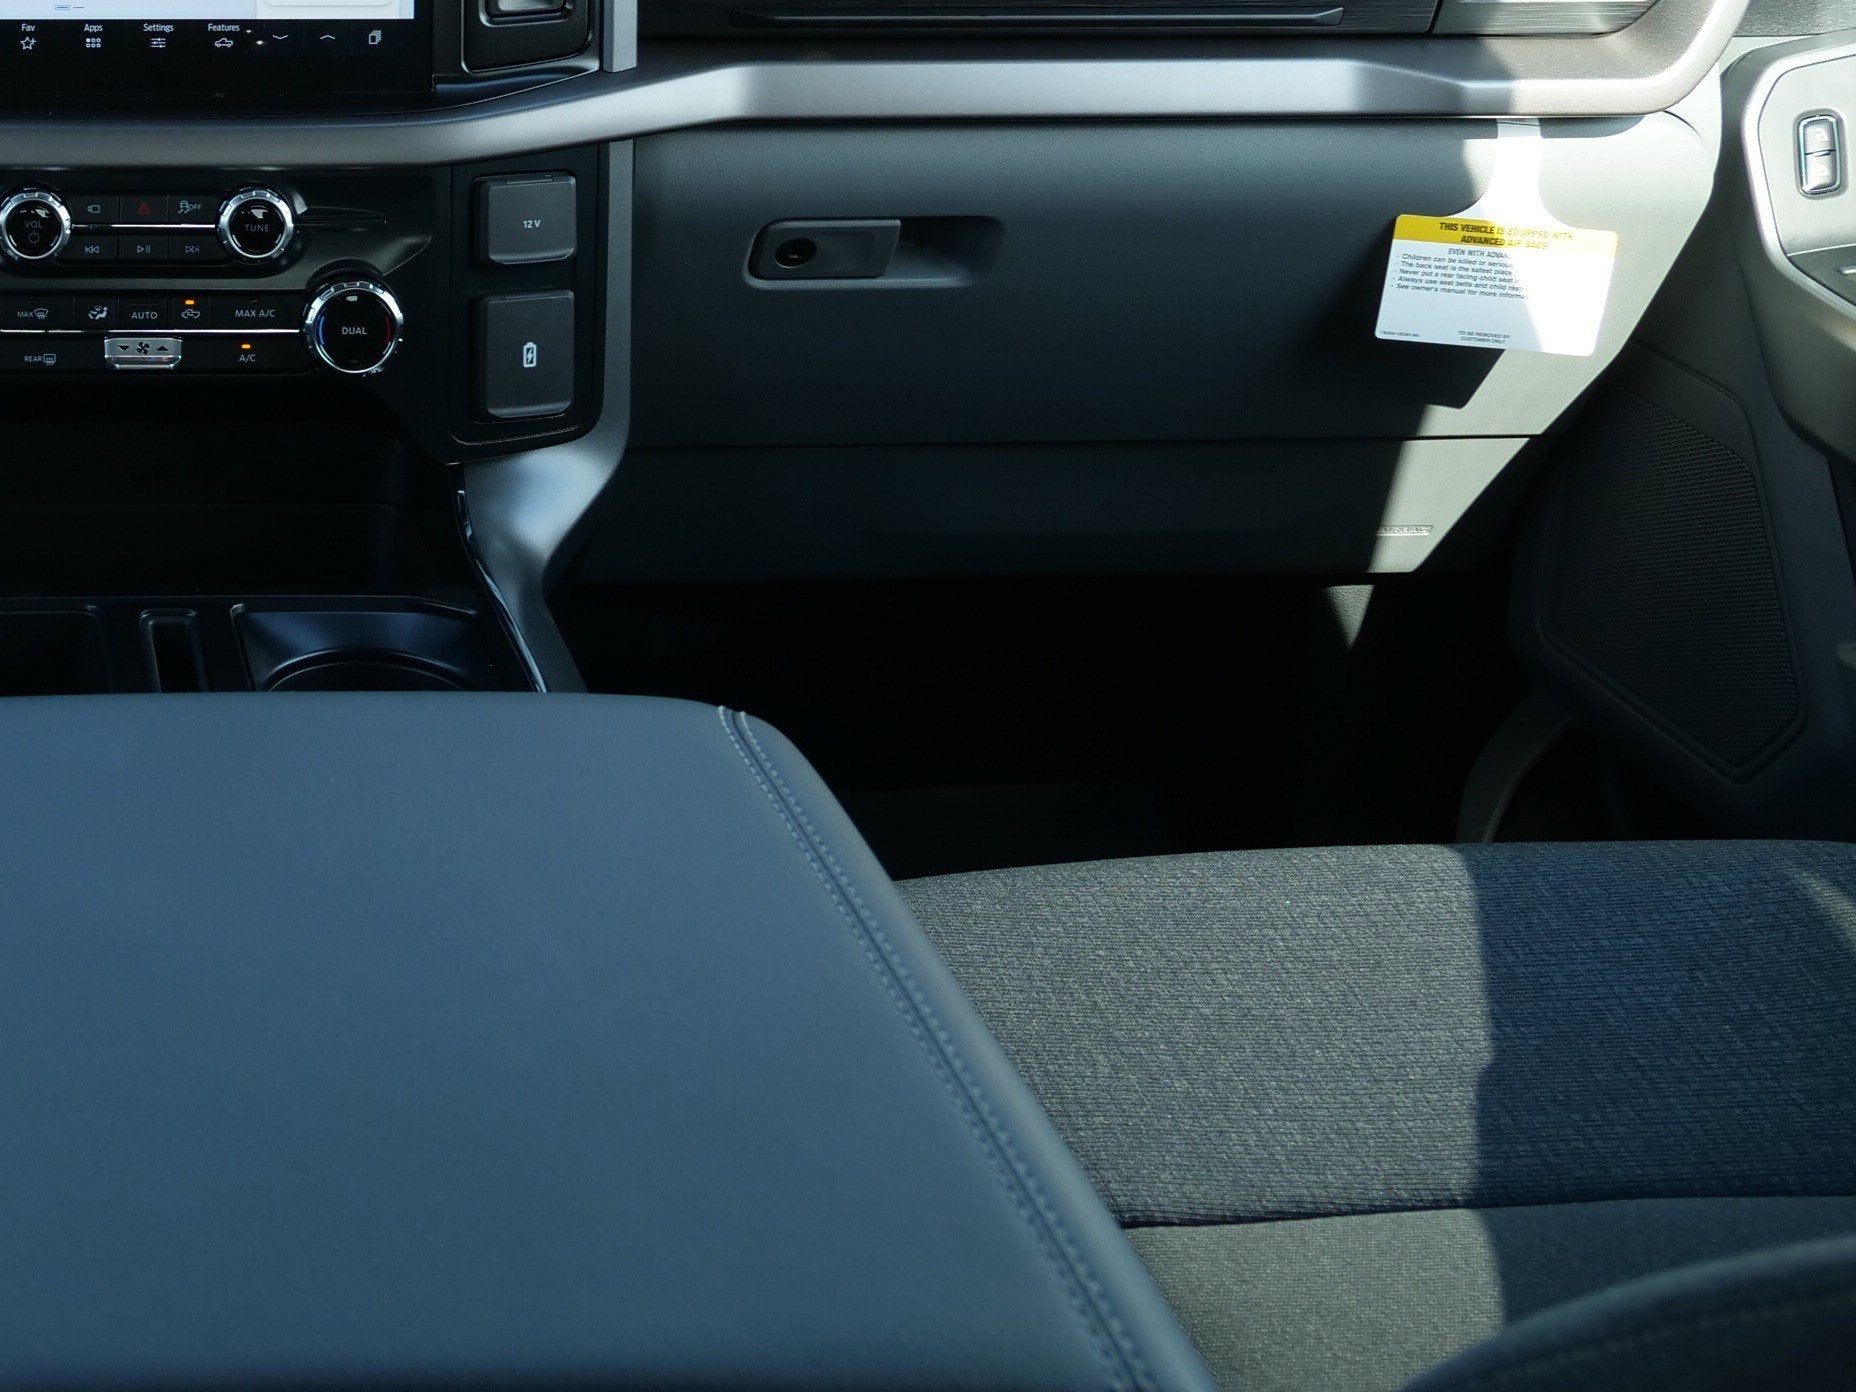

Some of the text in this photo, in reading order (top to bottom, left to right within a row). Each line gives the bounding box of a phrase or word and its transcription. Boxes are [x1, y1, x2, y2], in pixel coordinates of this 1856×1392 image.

[21, 23, 36, 33] Fav
[84, 23, 103, 34] Apps
[143, 23, 174, 34] Settings
[207, 23, 240, 33] Features
[188, 203, 202, 212] OFF
[23, 220, 44, 230] VOL
[244, 223, 270, 233] TUNE
[1439, 221, 1459, 231] THIS
[1460, 223, 1495, 235] VEHICLE
[1496, 226, 1505, 236] IS
[1460, 235, 1505, 247] ADVANCED
[1448, 247, 1466, 256] EVEN
[1402, 253, 1432, 262] Children
[17, 310, 34, 319] MAX
[131, 311, 158, 321] AUTO
[235, 308, 276, 319] MAX A/C
[341, 326, 368, 336] DUAL
[24, 354, 44, 363] REAR
[239, 353, 256, 364] A/C
